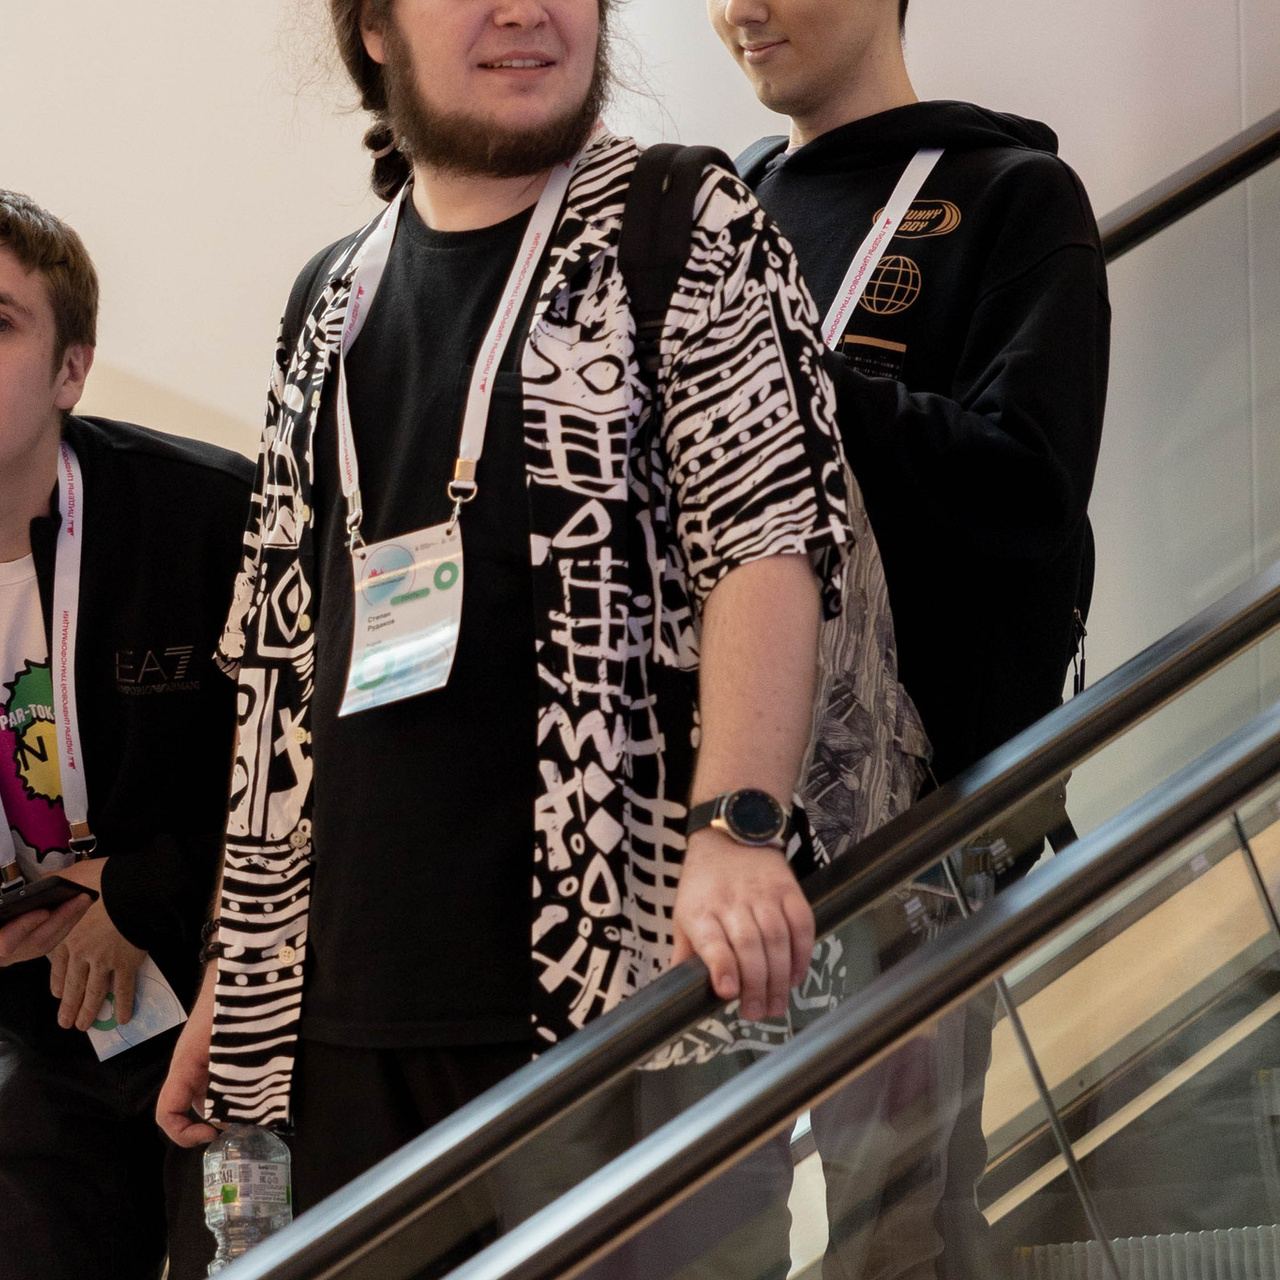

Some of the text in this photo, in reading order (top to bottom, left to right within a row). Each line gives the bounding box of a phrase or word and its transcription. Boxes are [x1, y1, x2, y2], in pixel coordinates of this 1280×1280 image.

[898, 221, 929, 232] BOY
[904, 208, 943, 220] UNNY
[825, 230, 886, 346] ЛИДЕРЫ ЦИФРОВОЙ ТРАНСФОРМА
[61, 610, 69, 682] ТРАНСФОРМАЦИИ
[115, 645, 195, 683] EA7
[0, 704, 55, 731] PAR-TOK
[60, 683, 70, 725] ЦИФРОВОЙ
